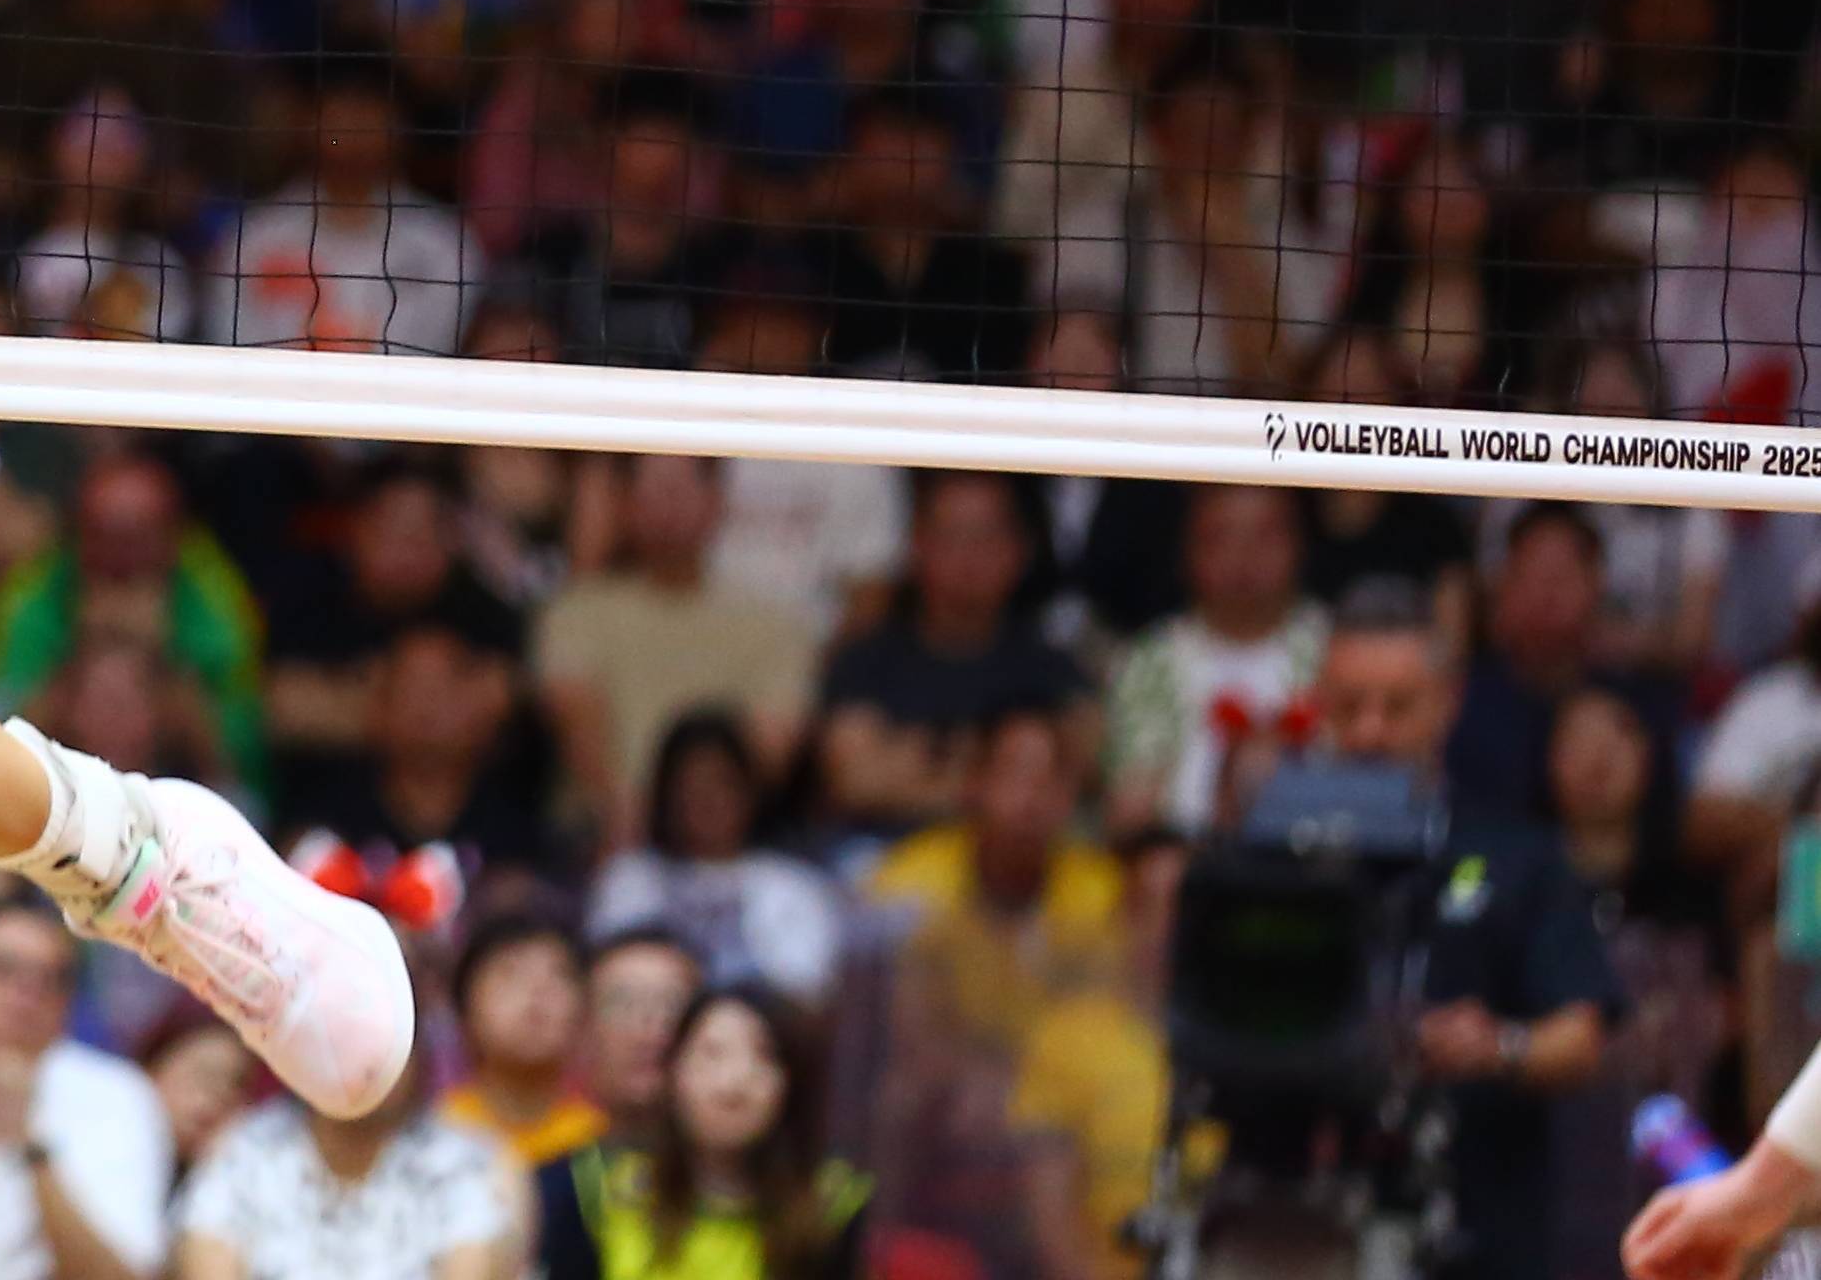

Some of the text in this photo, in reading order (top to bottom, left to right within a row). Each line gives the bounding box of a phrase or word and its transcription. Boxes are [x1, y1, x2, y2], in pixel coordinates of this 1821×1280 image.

[1296, 422, 1821, 477] VOLLEYBALL WORLD CHAMPIONSHIP 2025
